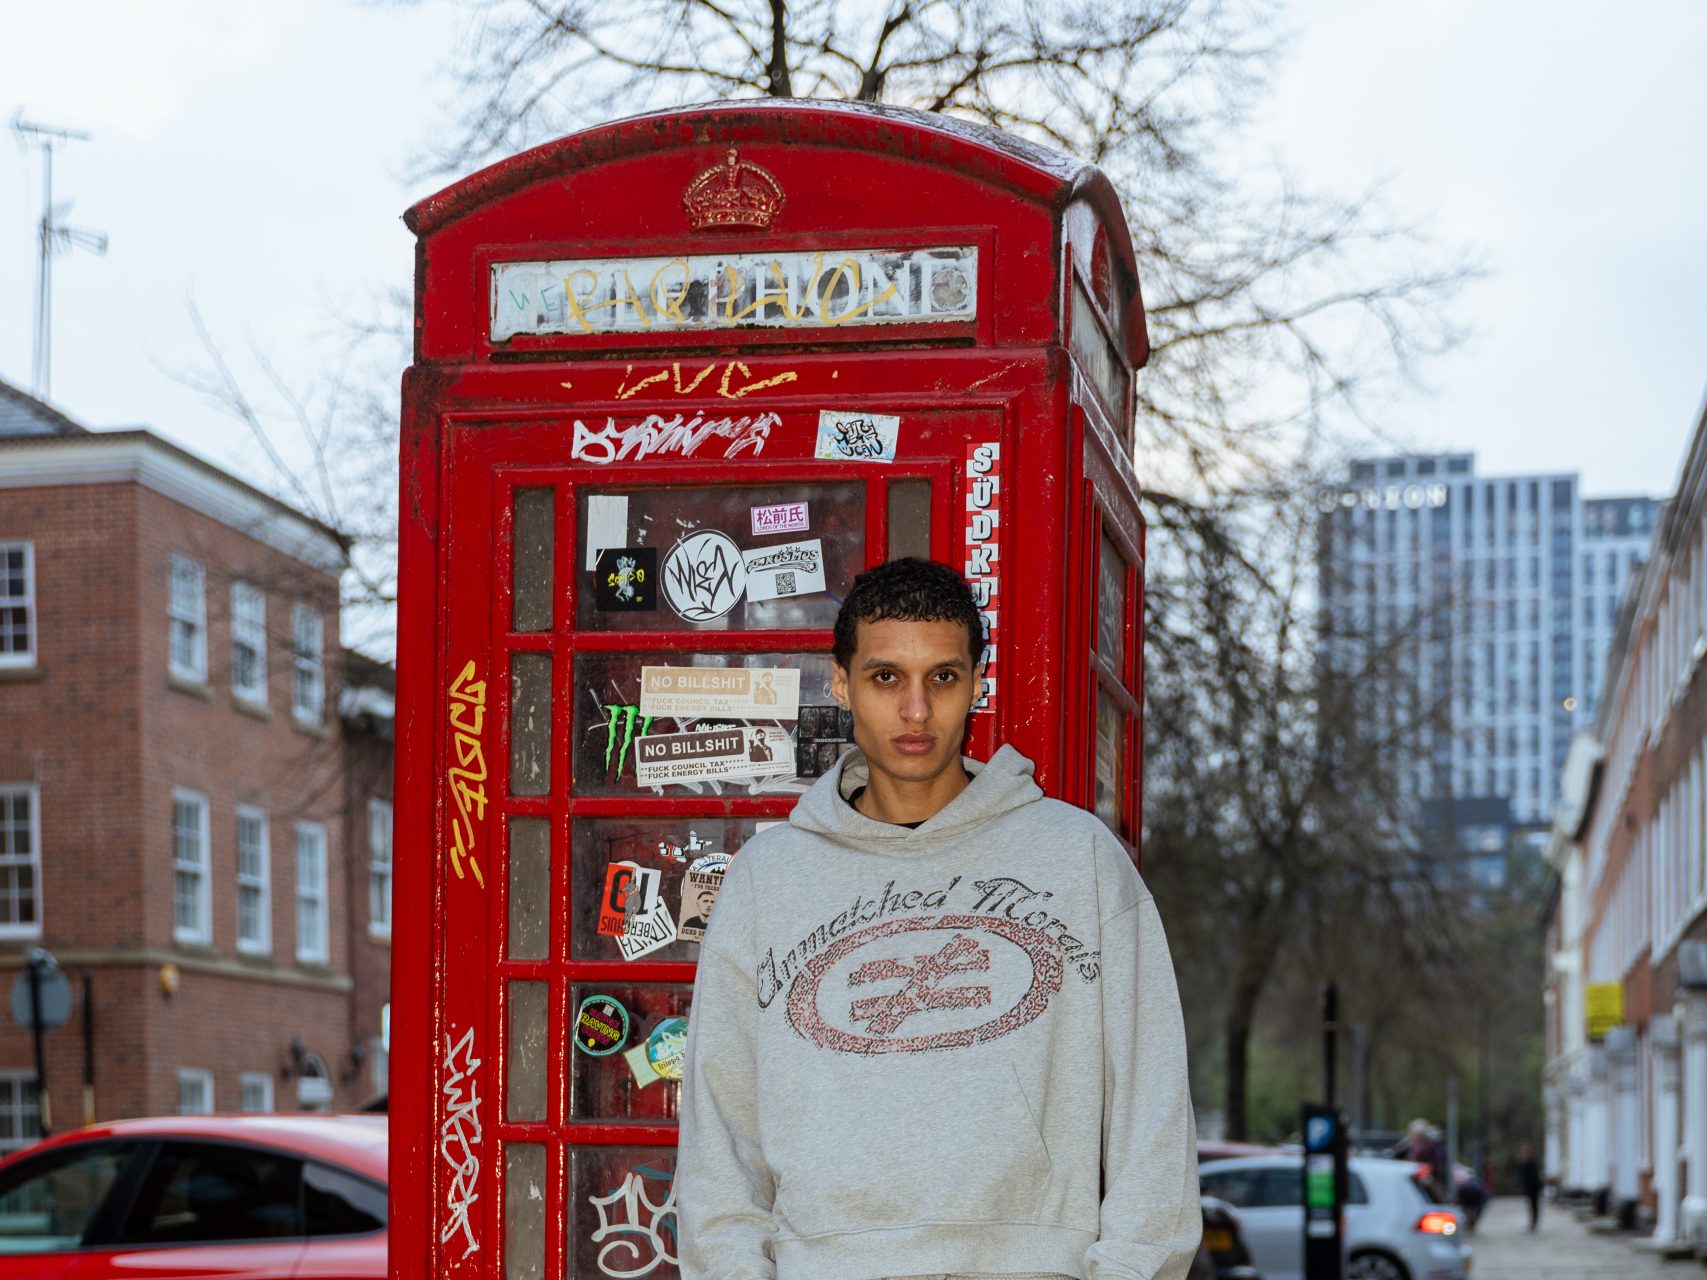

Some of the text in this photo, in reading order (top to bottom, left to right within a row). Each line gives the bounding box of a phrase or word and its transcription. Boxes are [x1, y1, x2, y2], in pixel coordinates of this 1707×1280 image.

[512, 258, 968, 330] TLEPHONE
[756, 505, 804, 526] 松前氏
[650, 674, 746, 689] NO BILLSHIT
[645, 737, 739, 757] NO BILLSHIT
[648, 760, 725, 773] FUCK COUNCIL TAX
[648, 767, 729, 780] FUCK ENERGY BILLS
